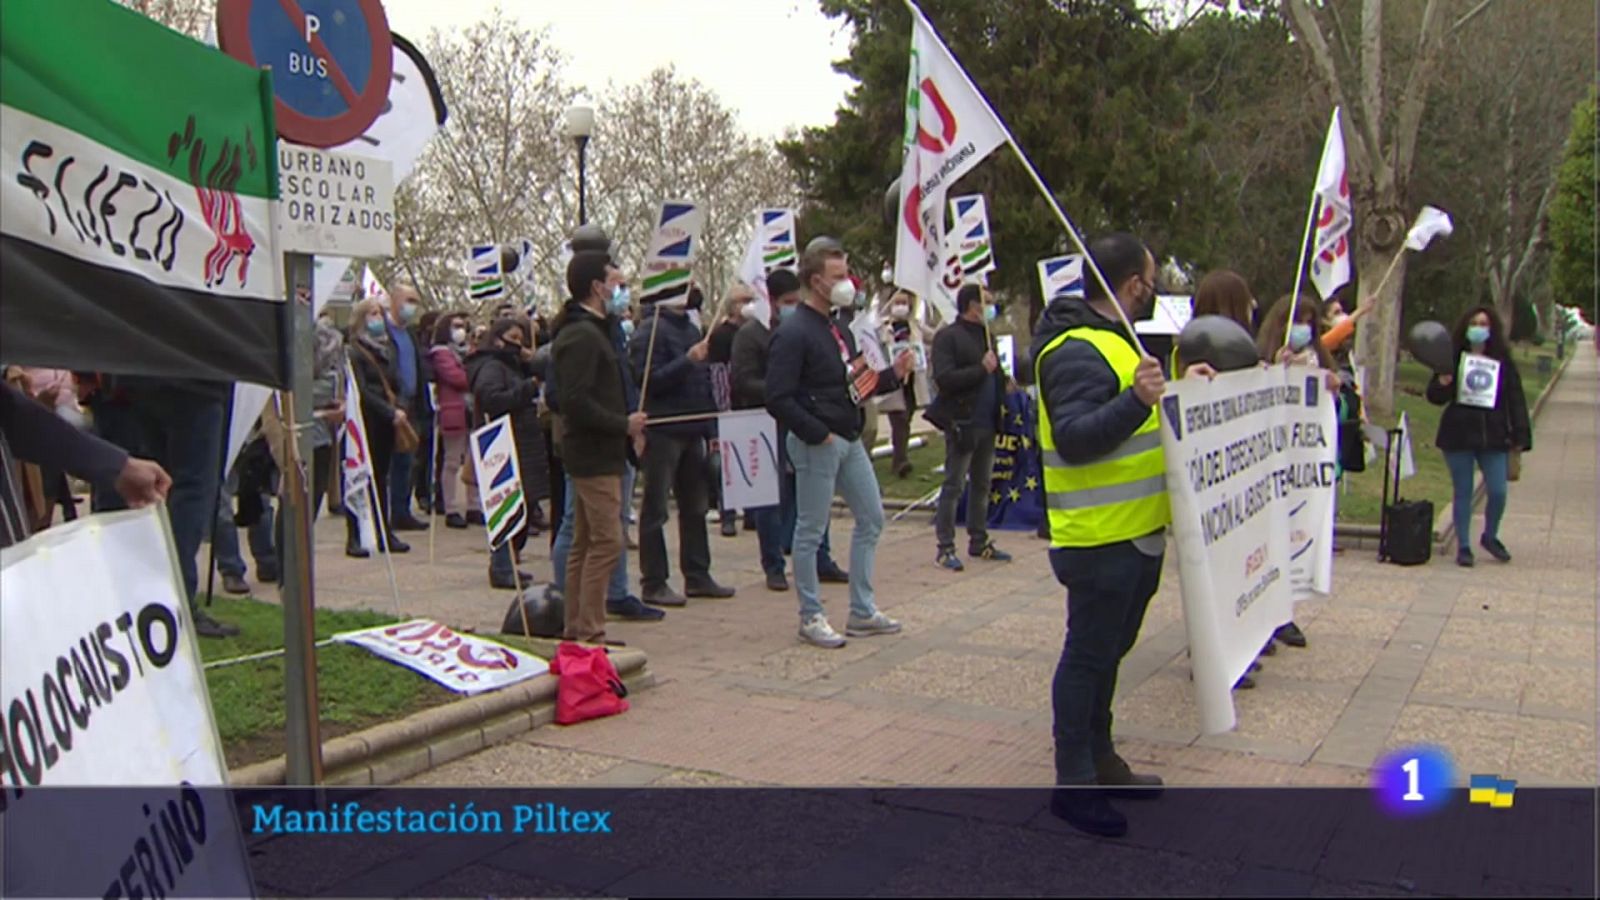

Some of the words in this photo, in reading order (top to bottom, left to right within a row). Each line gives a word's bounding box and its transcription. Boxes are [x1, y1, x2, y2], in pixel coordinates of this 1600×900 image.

[304, 14, 321, 43] P
[289, 51, 328, 78] BUS
[280, 151, 366, 180] URBANO
[280, 198, 394, 232] ORIZADOS
